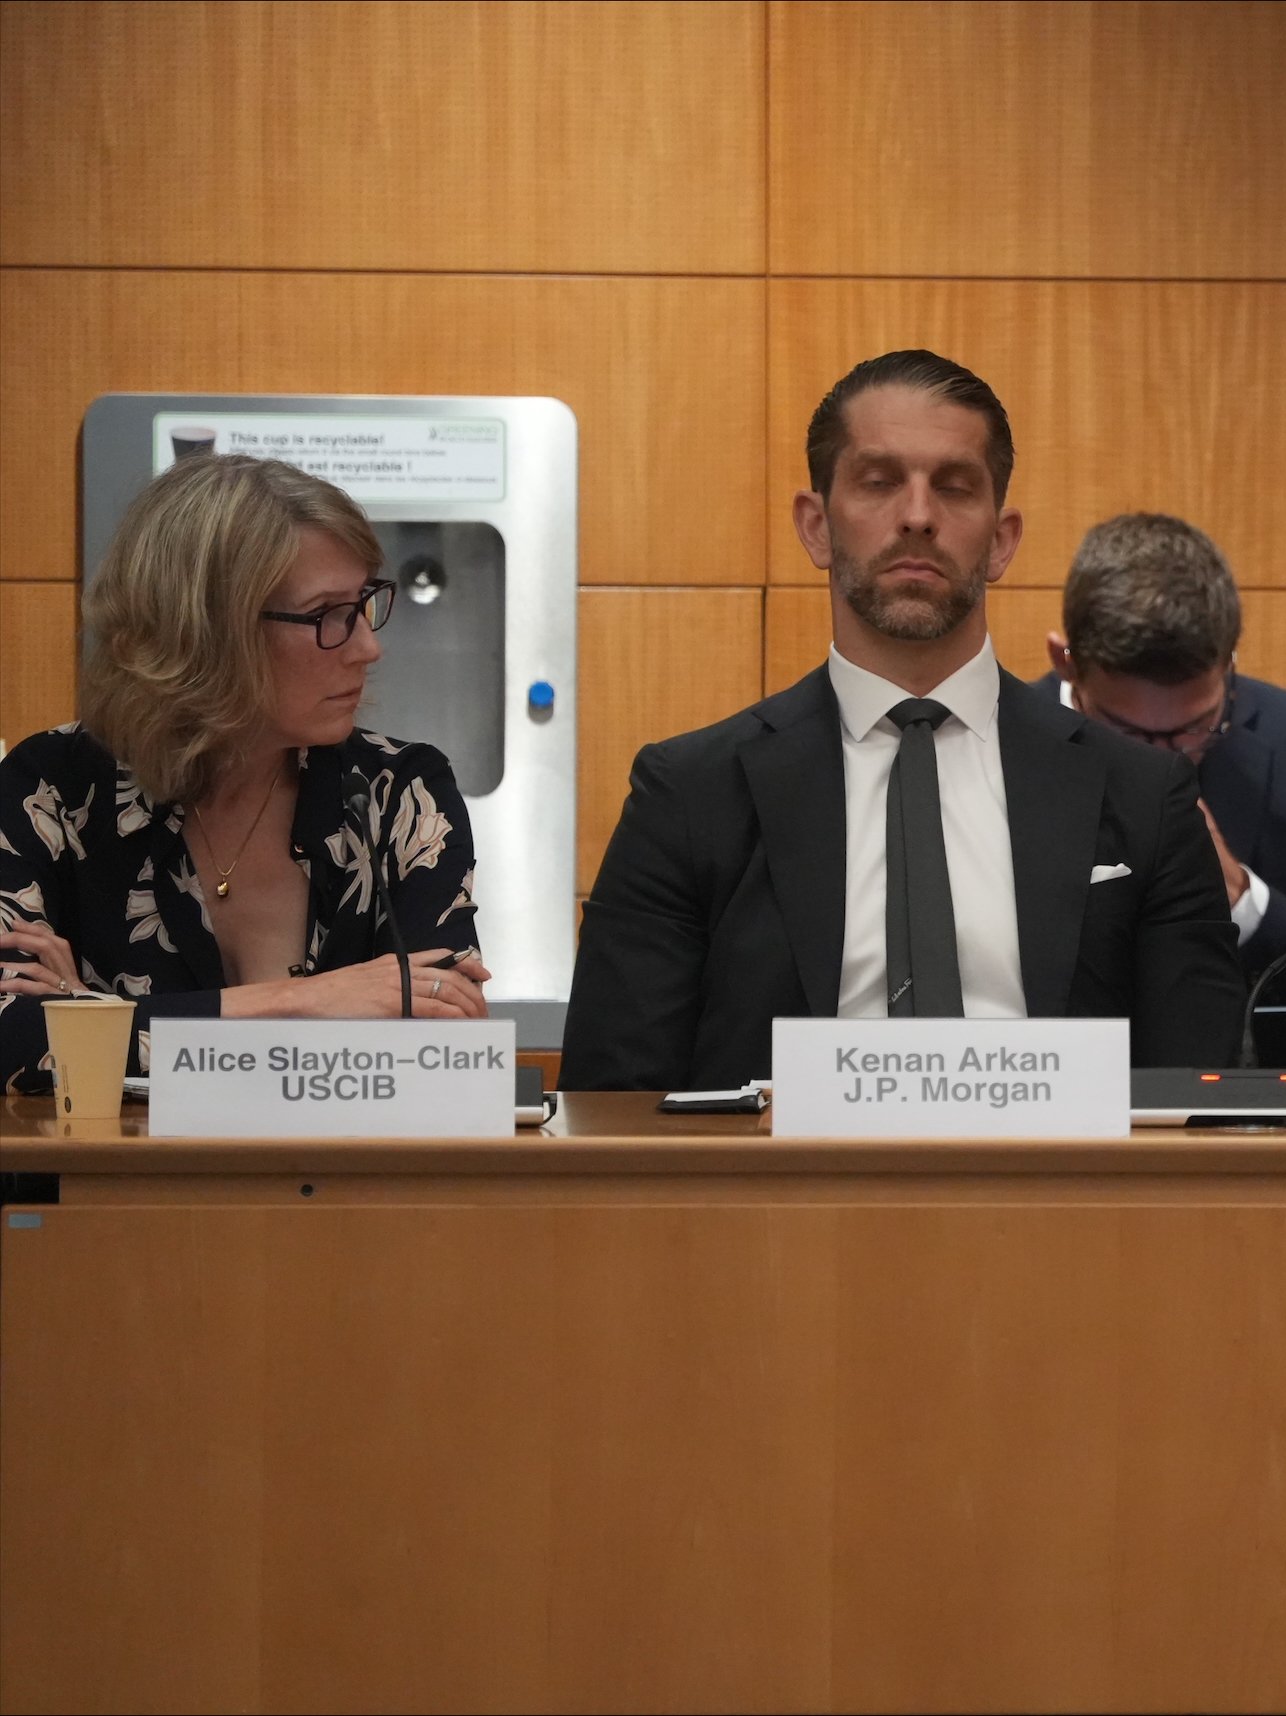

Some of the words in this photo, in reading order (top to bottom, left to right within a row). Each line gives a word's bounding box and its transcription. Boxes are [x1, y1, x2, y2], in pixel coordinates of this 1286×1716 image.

[230, 431, 258, 445] This
[263, 434, 289, 446] cup
[293, 433, 305, 445] is
[307, 461, 328, 472] est
[332, 460, 403, 474] recyclable
[173, 1047, 256, 1072] Alice
[836, 1048, 944, 1073] Kenan
[958, 1047, 1059, 1072] Arkan
[281, 1074, 396, 1101] USCIB
[844, 1077, 907, 1103] J.P.
[921, 1077, 1051, 1108] Morgan
